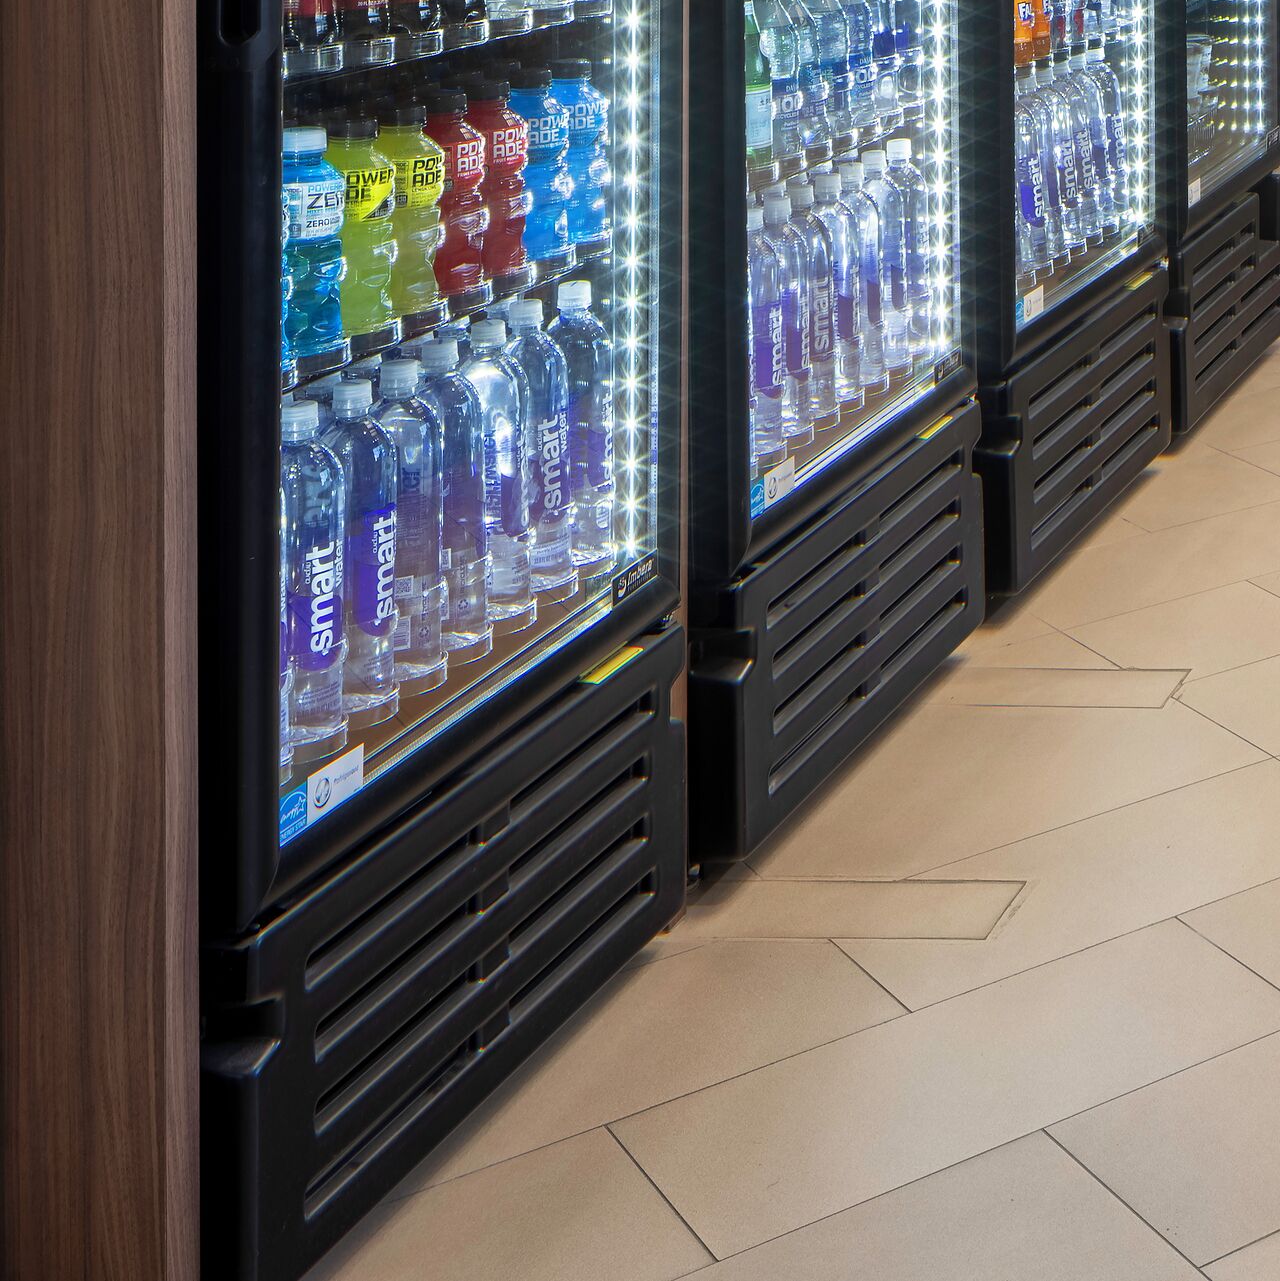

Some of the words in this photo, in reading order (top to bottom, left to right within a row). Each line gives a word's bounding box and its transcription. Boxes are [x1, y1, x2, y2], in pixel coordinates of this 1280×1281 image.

[493, 142, 523, 159] ADE
[1028, 157, 1045, 218] smart
[306, 219, 329, 228] ZERO
[811, 277, 829, 351] smart
[538, 415, 562, 511] smart
[559, 412, 569, 453] water
[335, 539, 344, 588] water
[374, 514, 396, 621] smart
[306, 541, 334, 654] smart
